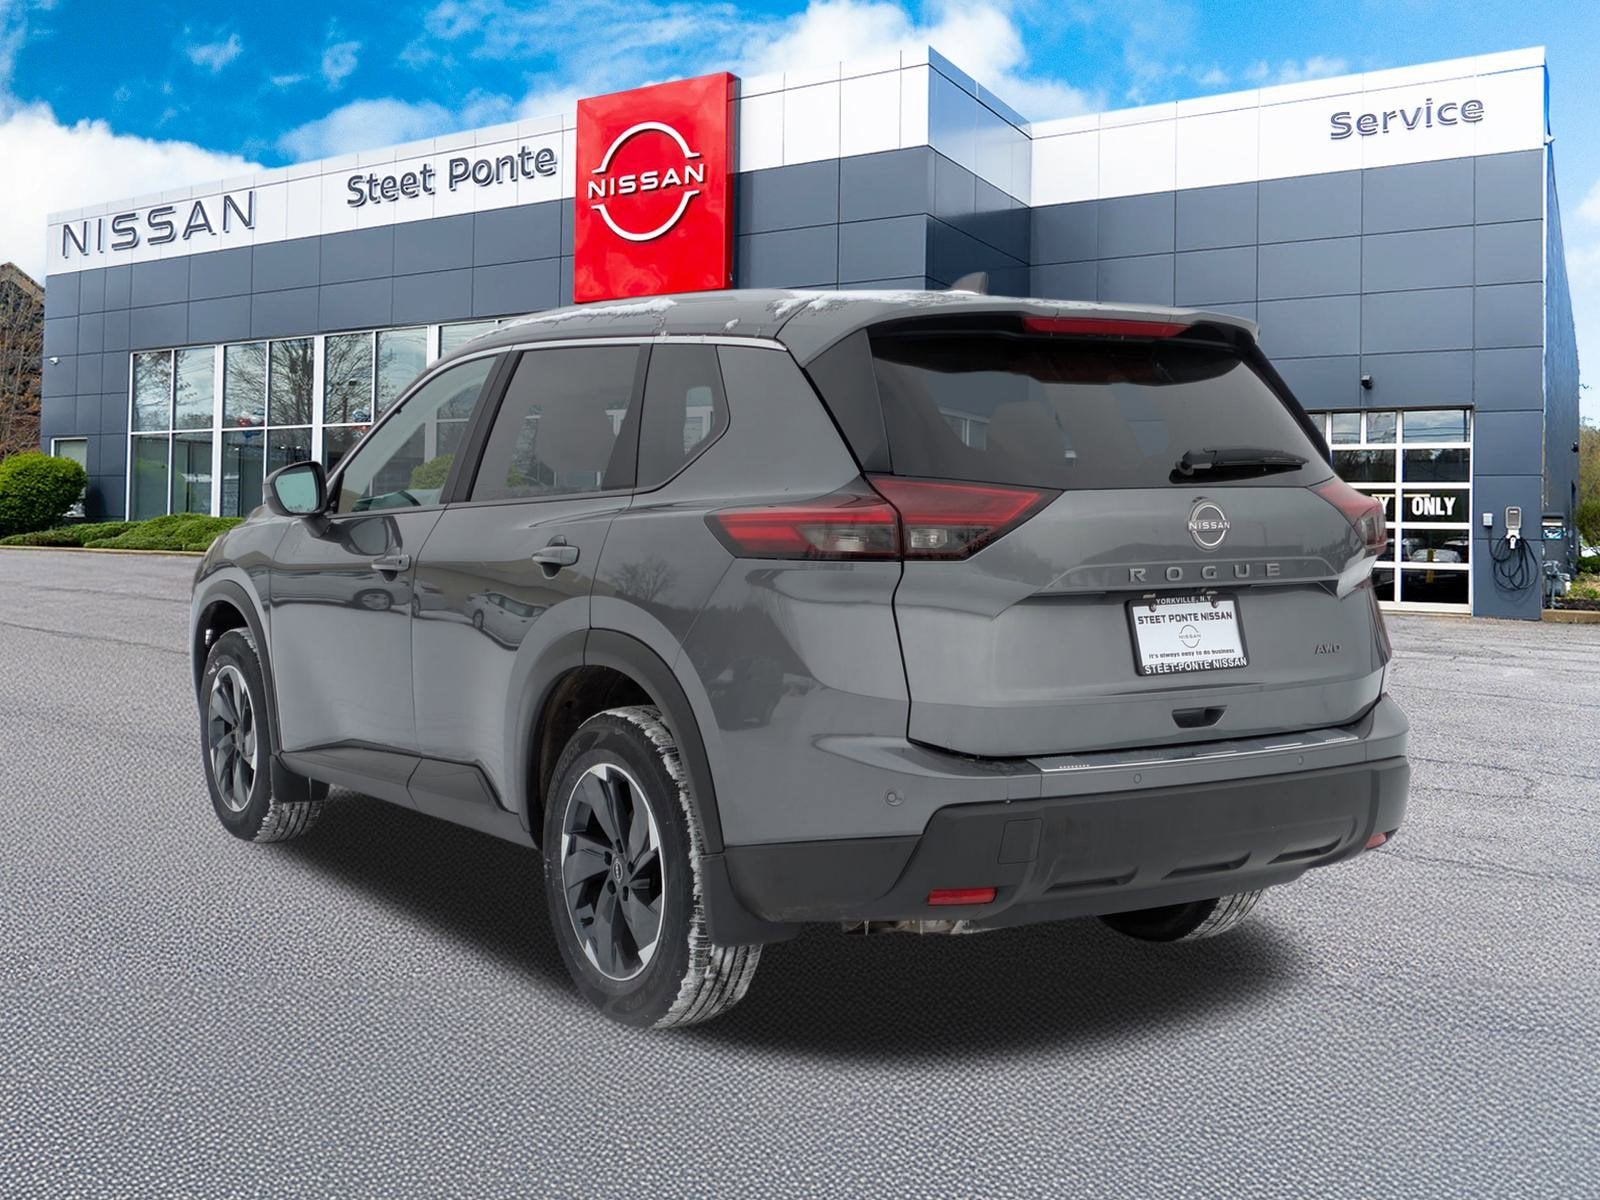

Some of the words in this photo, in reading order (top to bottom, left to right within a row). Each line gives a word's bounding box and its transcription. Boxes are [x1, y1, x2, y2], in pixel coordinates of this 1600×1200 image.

[1330, 98, 1485, 140] Service
[347, 163, 436, 207] Steet
[448, 145, 558, 192] Ponte
[588, 163, 705, 200] NISSAN
[62, 191, 256, 260] NISSAN
[1411, 496, 1457, 516] ONLY
[1188, 521, 1231, 531] NISSAN
[1128, 562, 1281, 583] ROGUE
[1138, 614, 1166, 624] STEET
[1169, 612, 1199, 622] PONTE
[1200, 611, 1233, 621] NISSAN
[1160, 651, 1181, 659] always
[1144, 661, 1210, 674] STEET-PONTE
[1212, 657, 1247, 669] NISSAN
